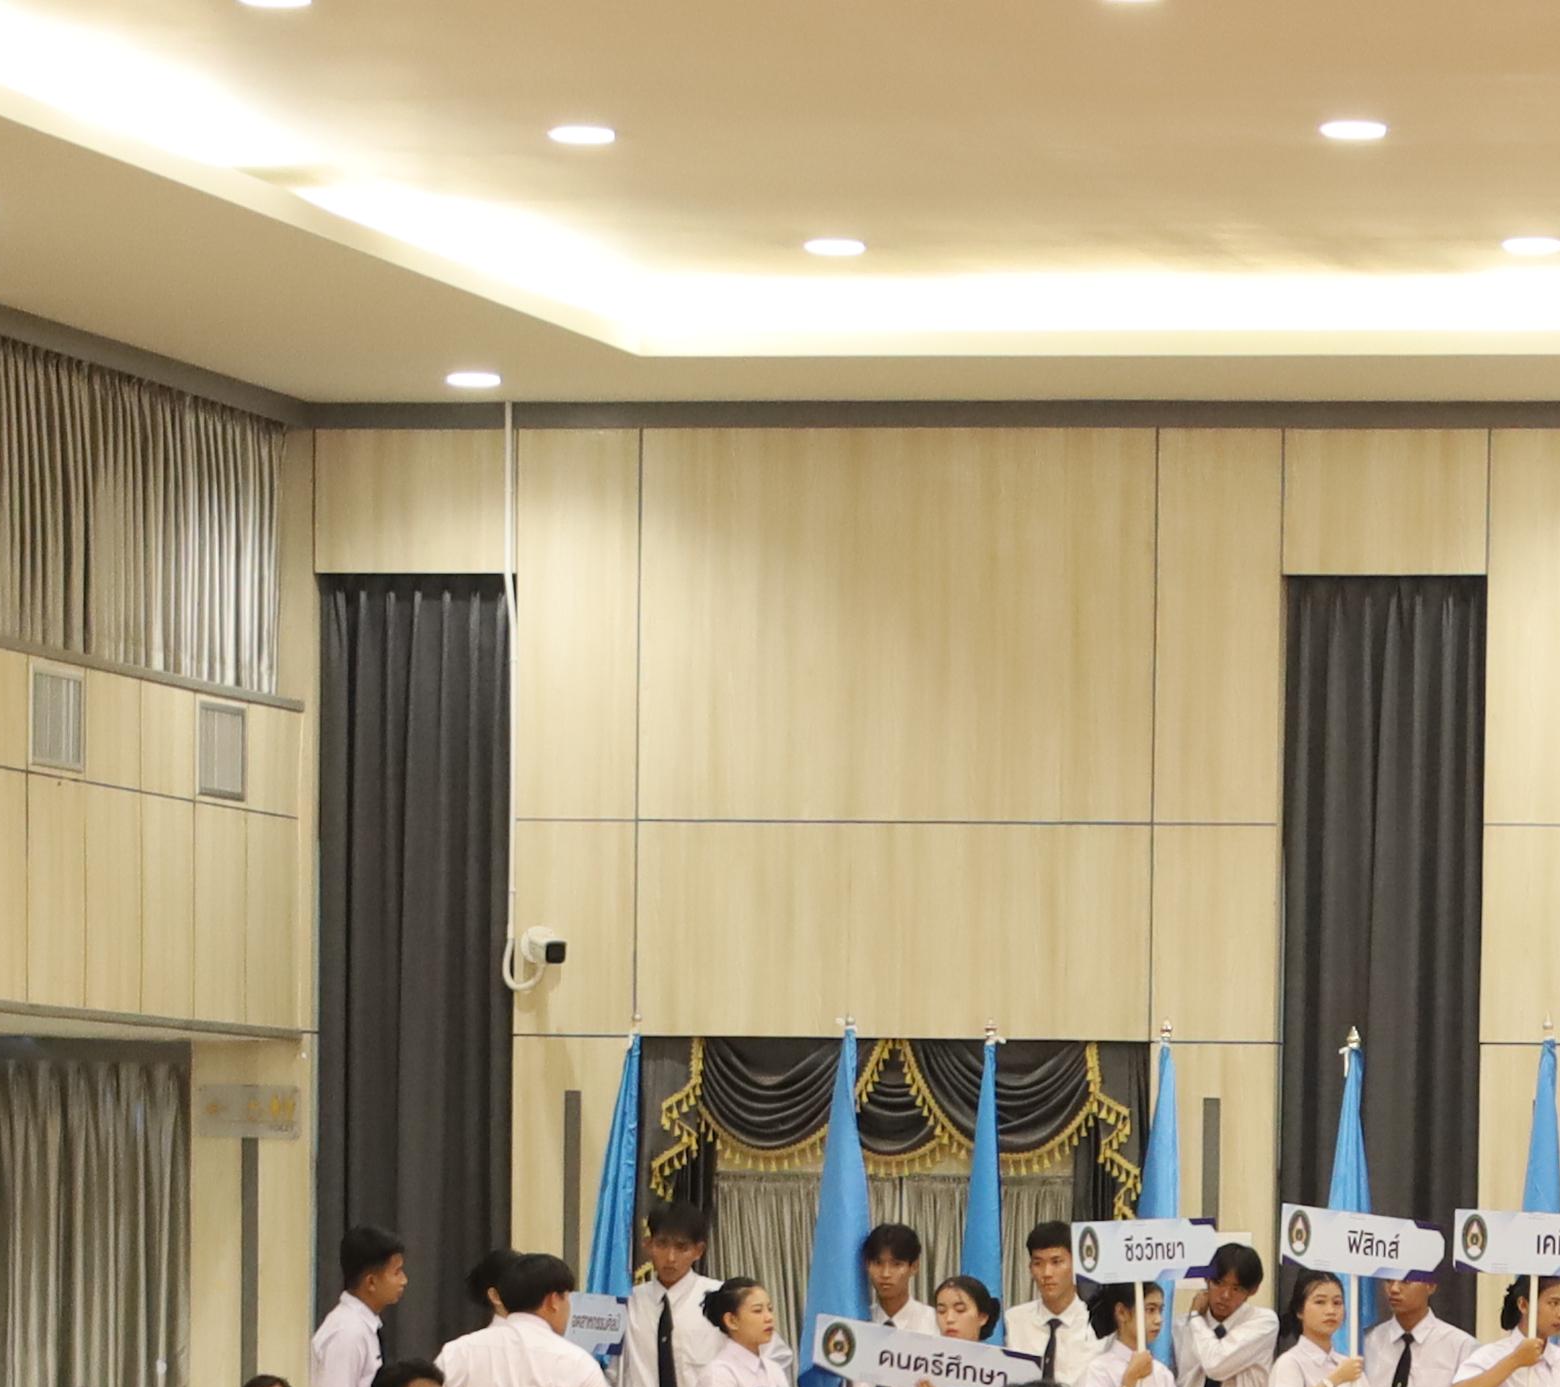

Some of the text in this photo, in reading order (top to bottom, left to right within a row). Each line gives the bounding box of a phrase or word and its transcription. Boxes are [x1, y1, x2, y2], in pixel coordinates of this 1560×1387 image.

[1123, 1235, 1185, 1262] ชีววิทยา
[1347, 1230, 1400, 1260] ฟิสิกส์
[878, 1350, 1008, 1386] ดนตรีศึกษา
